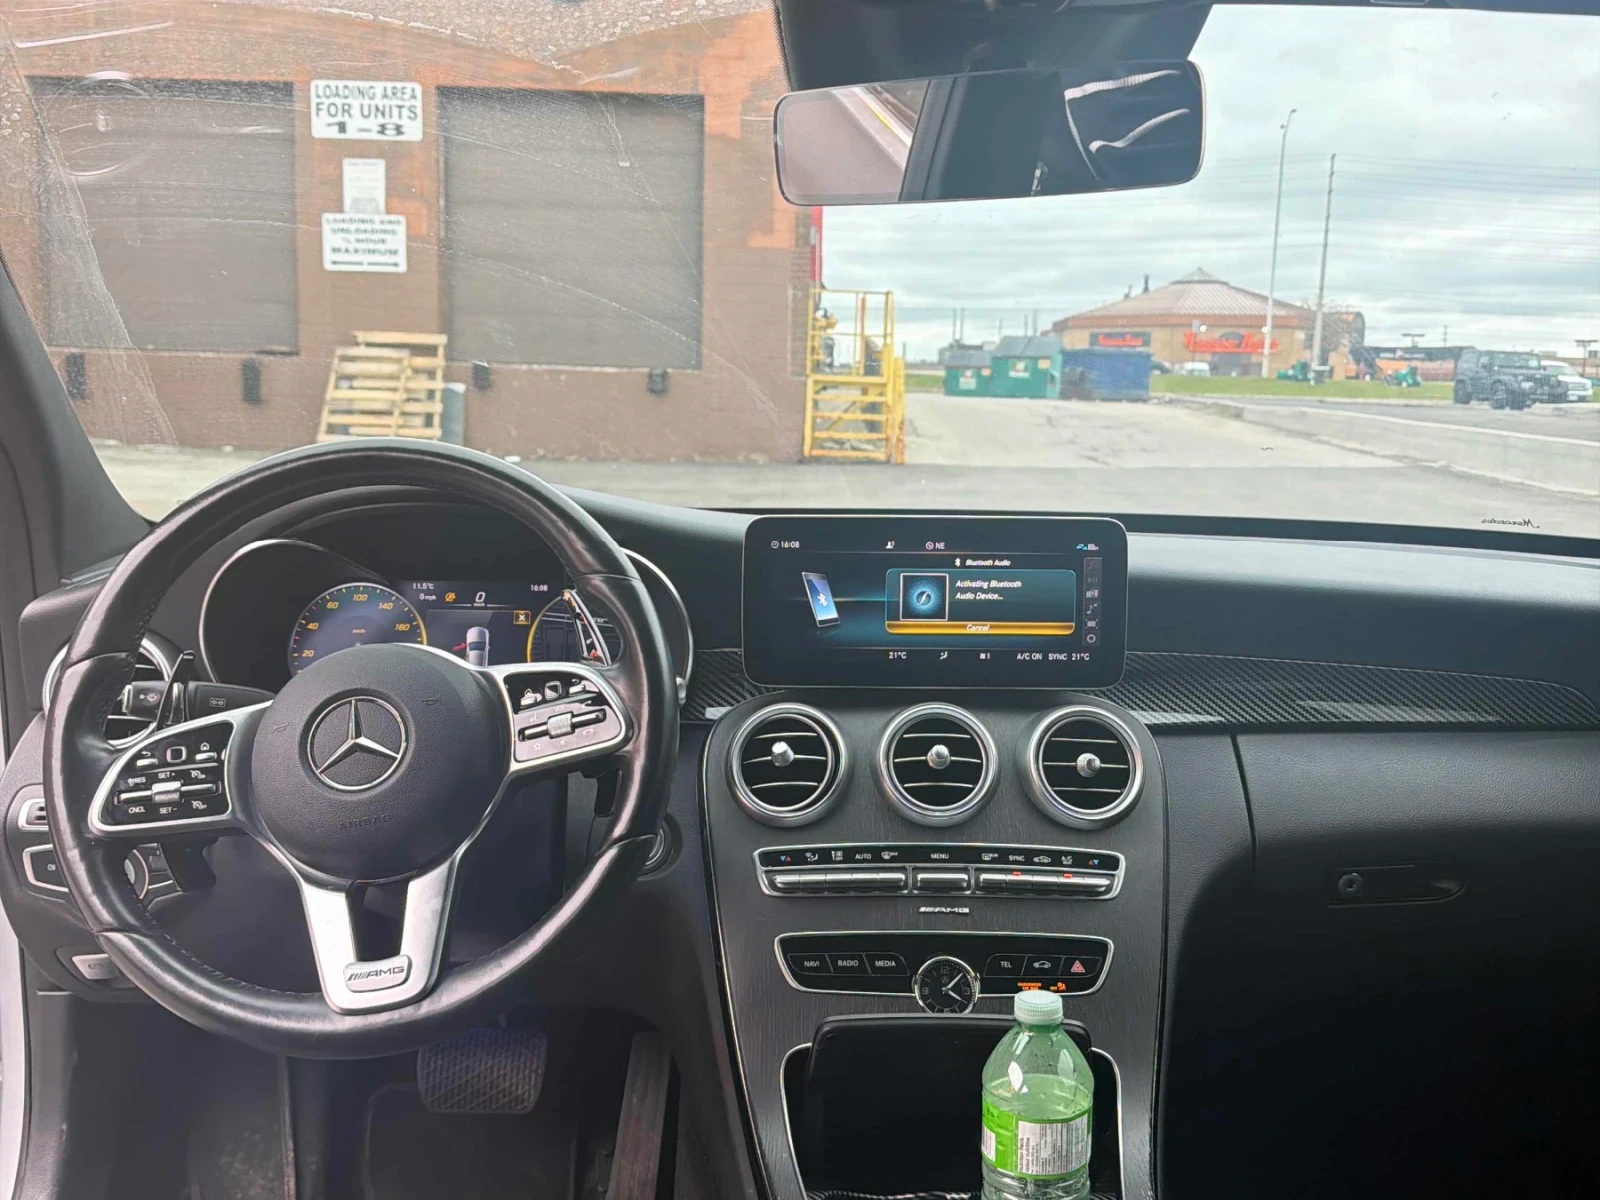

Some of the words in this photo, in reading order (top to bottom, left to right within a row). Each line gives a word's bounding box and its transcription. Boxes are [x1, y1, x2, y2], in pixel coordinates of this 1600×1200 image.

[315, 84, 376, 100] LOADING
[381, 86, 418, 102] AREA
[315, 102, 353, 118] FOR
[360, 104, 418, 121] UNITS
[780, 540, 800, 549] 16:08
[935, 541, 946, 550] NE
[965, 558, 993, 567] Bluetooth
[994, 559, 1011, 567] Audio
[530, 584, 549, 592] 16:08
[955, 580, 989, 590] Activating
[989, 580, 1022, 588] Bluetooth
[352, 593, 369, 603] 100
[475, 591, 486, 603] 0
[955, 592, 975, 600] Audio
[377, 602, 394, 610] 140
[306, 622, 319, 631] 40
[966, 623, 990, 632] Cancel
[302, 650, 315, 659] 20
[888, 652, 907, 660] 21°C
[1016, 653, 1030, 661] A/C
[1031, 653, 1043, 661] ON
[1048, 653, 1068, 661] SYNC
[1071, 653, 1090, 661] 21°C
[855, 853, 872, 861] AUTO
[930, 853, 950, 861] MENU
[1008, 854, 1026, 863] SYNC
[803, 960, 820, 968] NAVI
[837, 959, 859, 967] RADIO
[875, 959, 896, 968] MEDIA
[1000, 960, 1012, 969] TEL
